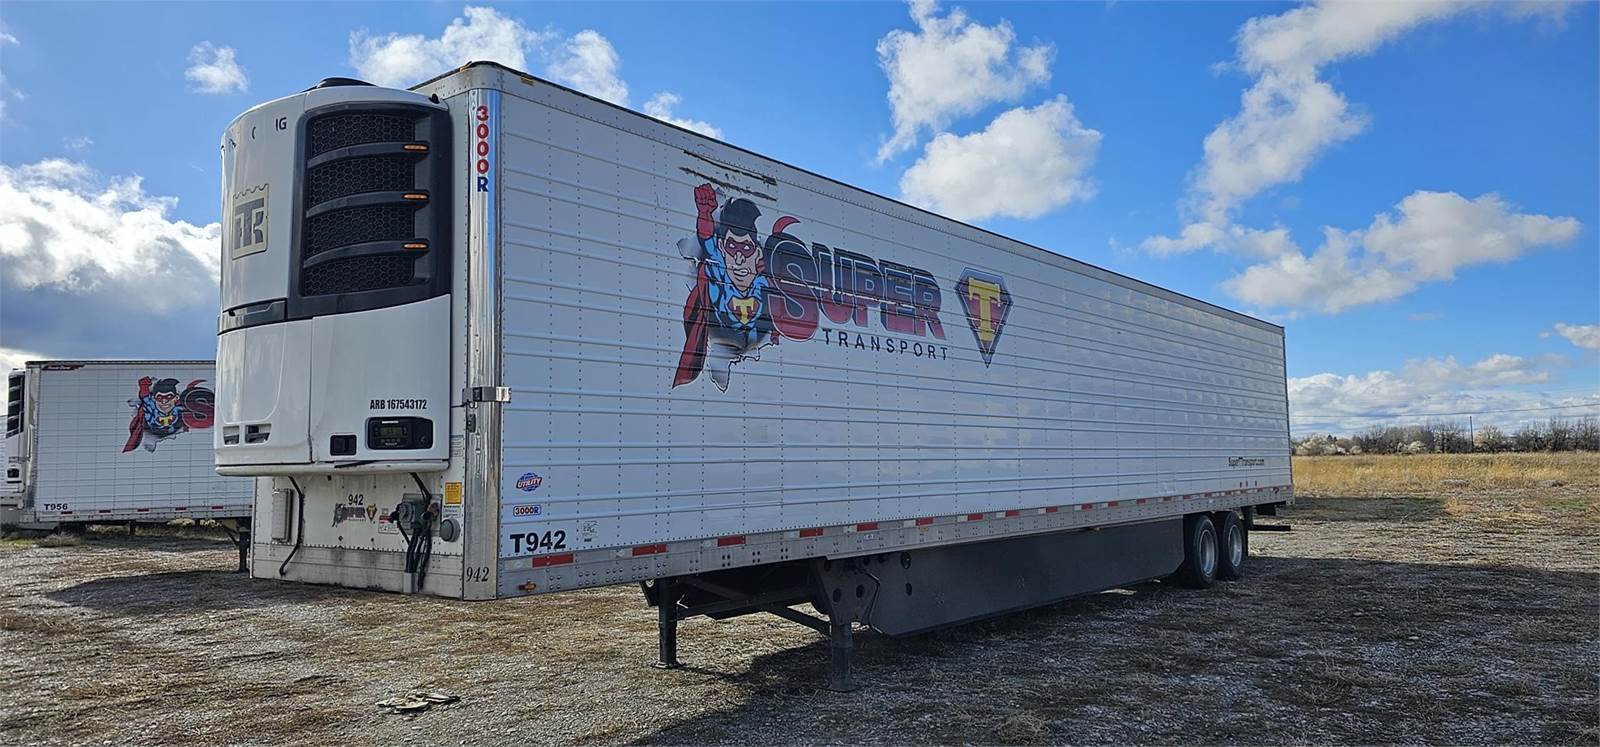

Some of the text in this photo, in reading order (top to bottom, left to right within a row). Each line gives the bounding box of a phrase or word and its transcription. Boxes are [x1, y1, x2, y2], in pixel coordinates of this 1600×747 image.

[476, 105, 490, 192] 3000R
[762, 232, 947, 342] SUPER
[821, 327, 949, 361] TRANSPORT
[369, 399, 428, 410] ARB 167543172
[516, 477, 541, 488] UTILITY
[44, 503, 68, 511] T956
[347, 494, 364, 506] 942
[515, 506, 539, 515] 3000R
[509, 530, 567, 554] T942
[465, 566, 490, 583] 942
